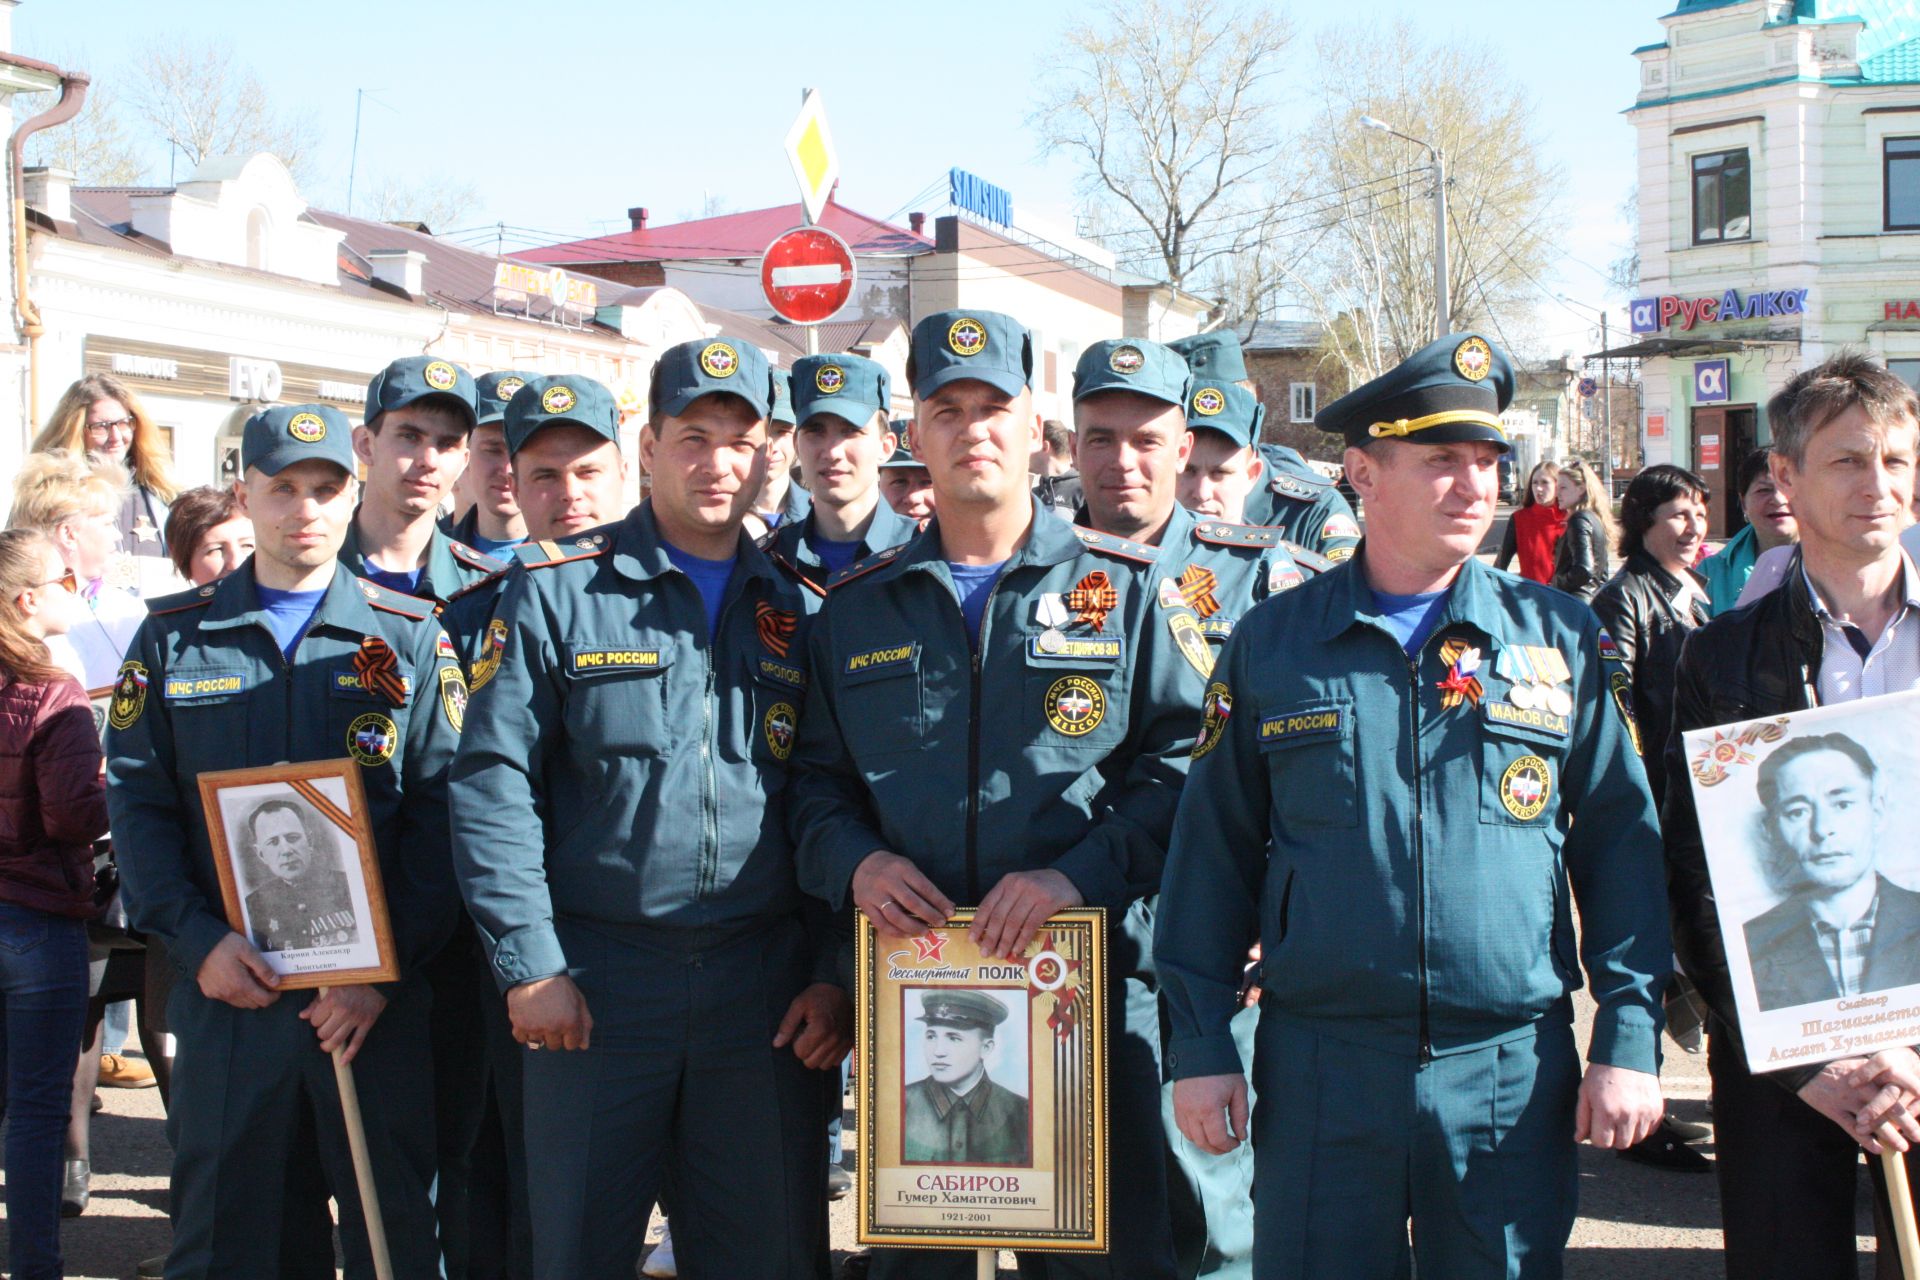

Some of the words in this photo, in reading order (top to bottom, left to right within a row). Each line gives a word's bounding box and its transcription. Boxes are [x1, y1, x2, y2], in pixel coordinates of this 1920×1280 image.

[950, 167, 1013, 228] SAMSUNG
[229, 357, 282, 402] EVO
[577, 653, 604, 668] МЧС
[607, 652, 657, 665] РОССИИ
[849, 654, 869, 670] МЧС
[871, 645, 912, 665] РОССИИ
[1036, 641, 1104, 656] МЕТДИЯРОВ
[760, 661, 800, 684] ФРОЛОВ
[169, 682, 193, 695] МЧС
[195, 677, 241, 693] РОССИИ
[1049, 682, 1065, 700] МЧС
[1067, 678, 1101, 701] РОССИИ
[1049, 709, 1101, 732] EMERCOM
[1262, 720, 1285, 737] МЧС
[1288, 713, 1337, 733] РОССИИ
[1490, 703, 1541, 726] МАНОВ
[1544, 713, 1568, 734] С.А.
[1508, 760, 1524, 779] МЧС
[1504, 794, 1542, 817] EMERCOM
[887, 951, 971, 982] бессмертный
[978, 966, 1024, 980] ПОЛК
[1836, 995, 1889, 1012] Снайпер
[1767, 1041, 1827, 1063] Асхат
[916, 1174, 1020, 1193] САБИРОВ
[897, 1190, 938, 1205] Гумер
[942, 1191, 1037, 1206] Хаматгатович
[941, 1212, 992, 1222] 1921-2001
